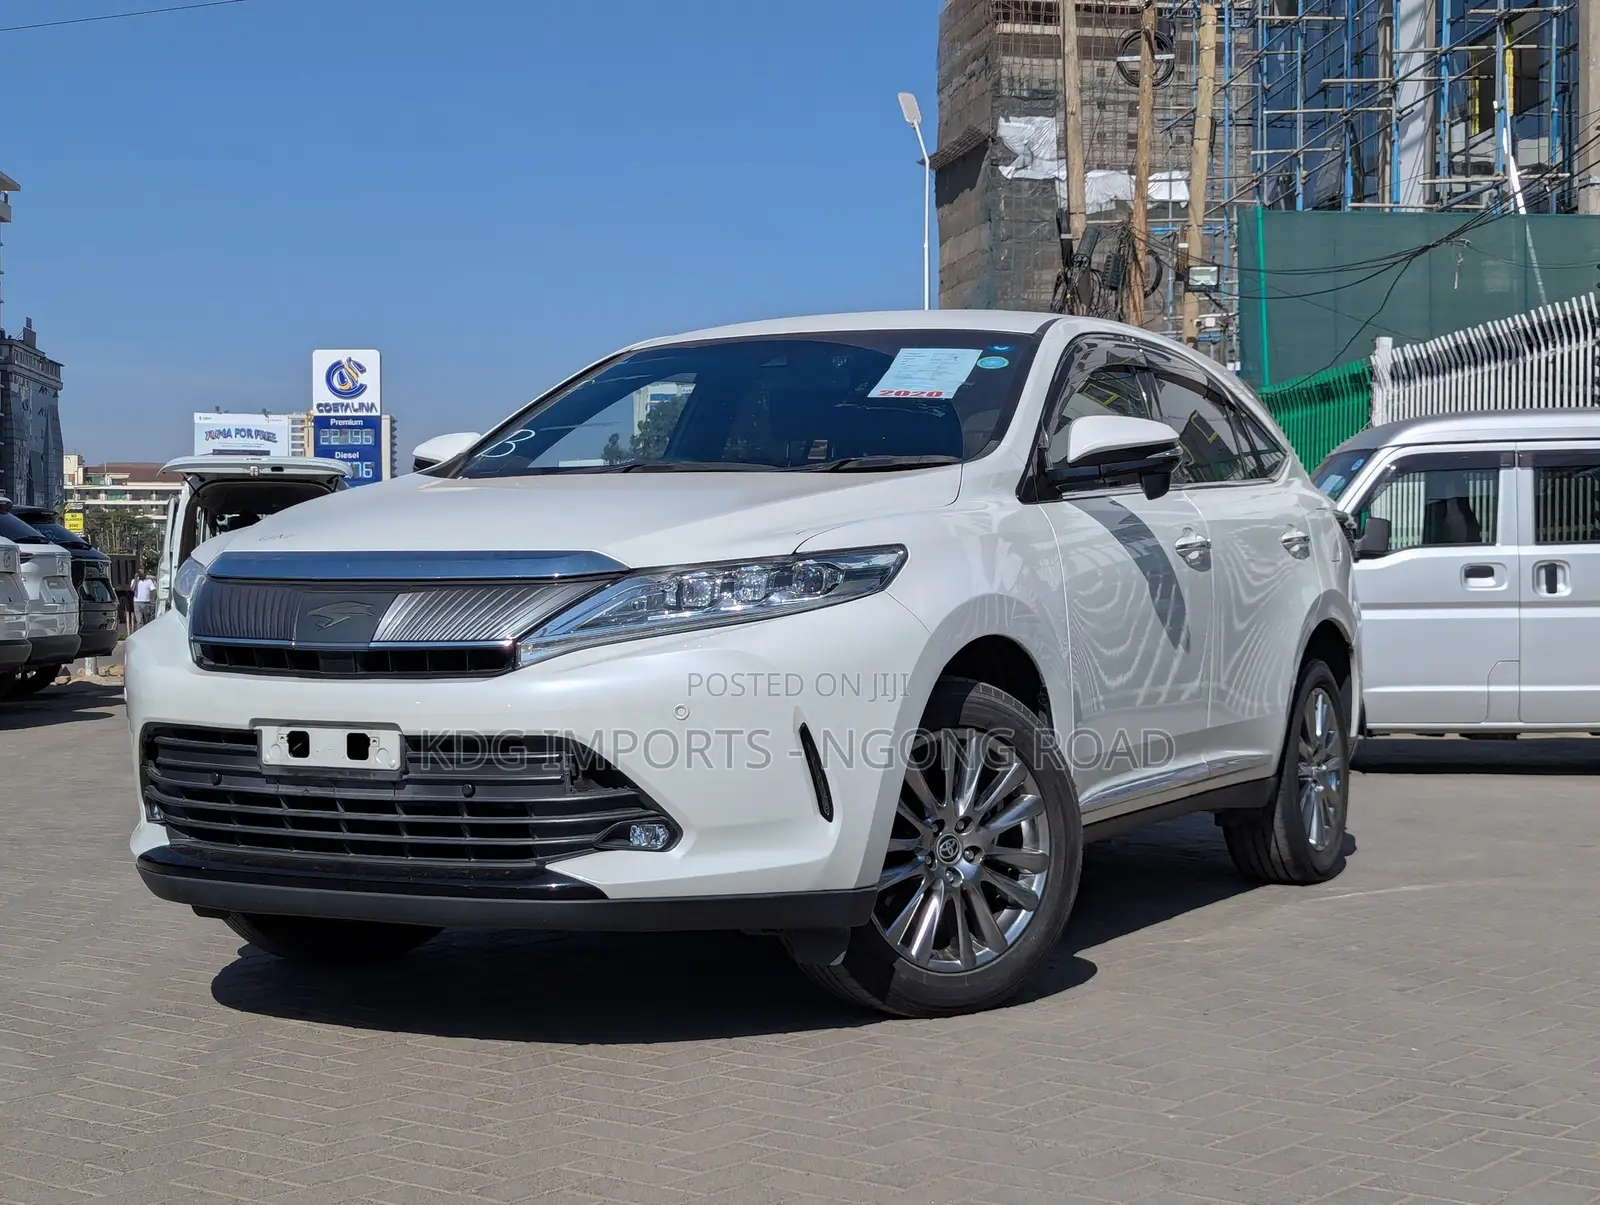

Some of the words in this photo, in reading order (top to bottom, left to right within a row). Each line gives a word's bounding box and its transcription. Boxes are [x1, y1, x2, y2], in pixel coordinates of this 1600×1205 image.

[879, 390, 944, 398] 2020
[316, 402, 378, 414] COSTALINA
[330, 418, 363, 426] Premium
[234, 427, 254, 439] FOR
[254, 429, 278, 443] FREE
[335, 451, 360, 459] Diesel
